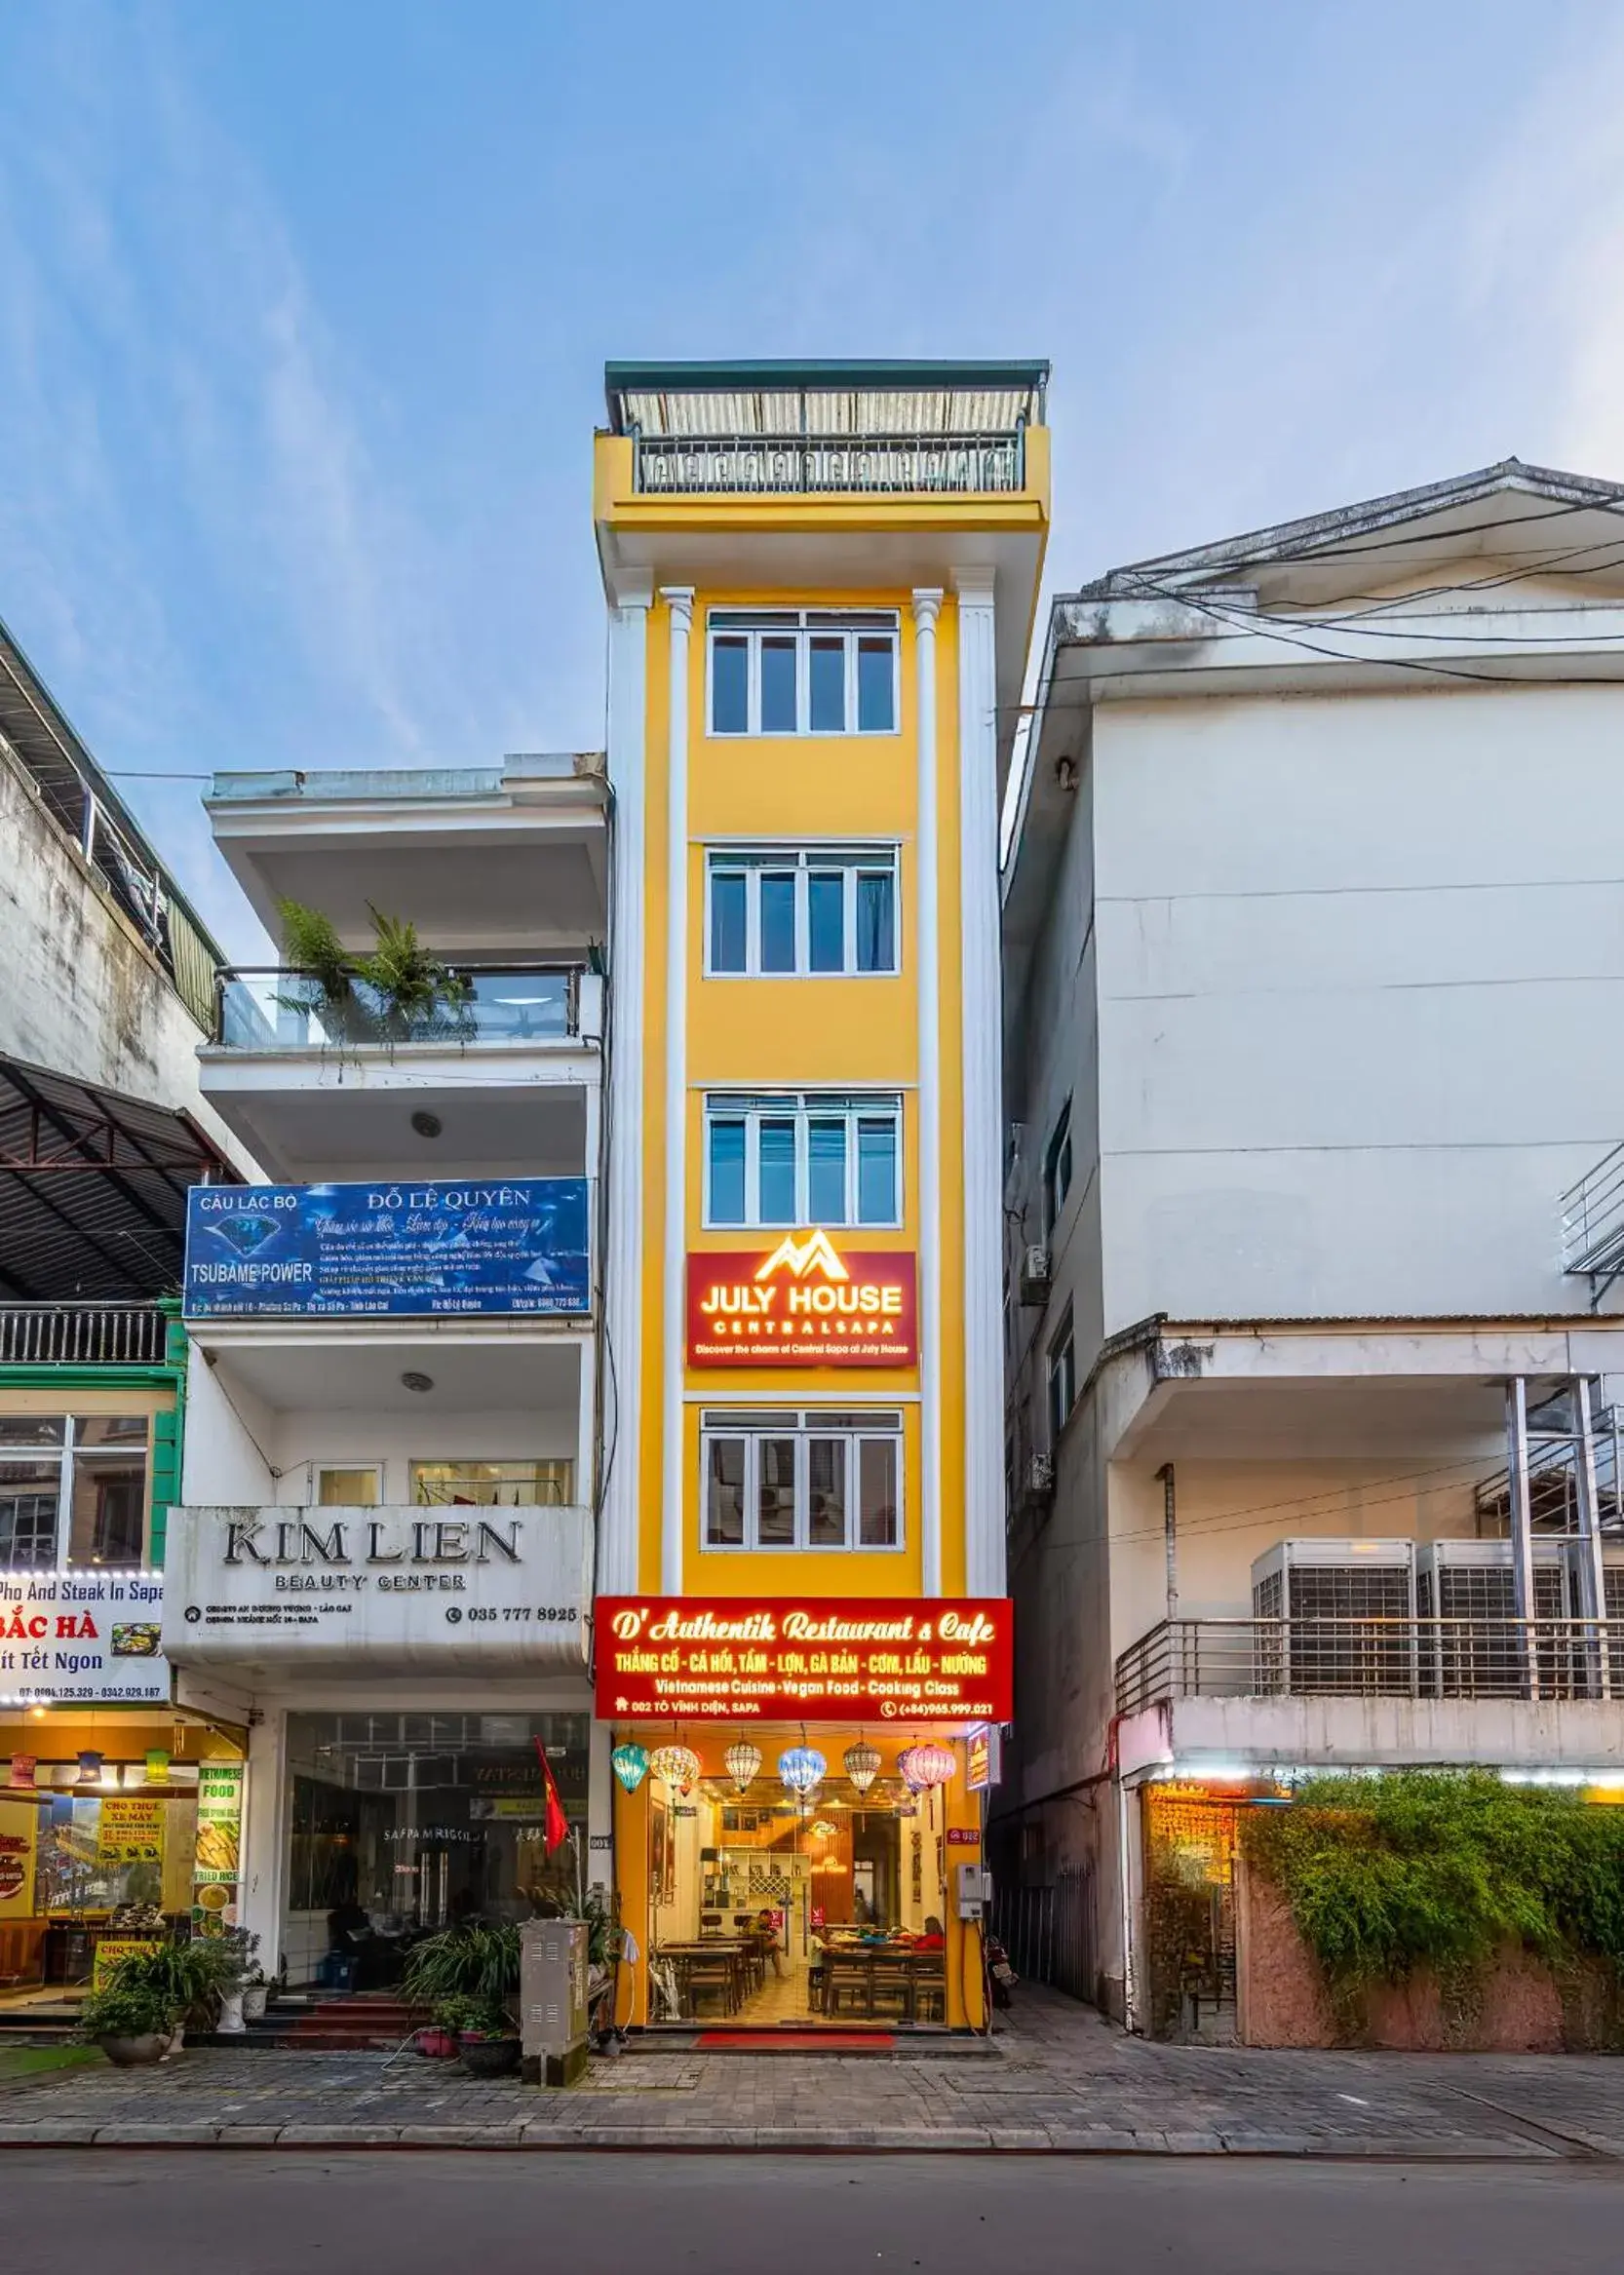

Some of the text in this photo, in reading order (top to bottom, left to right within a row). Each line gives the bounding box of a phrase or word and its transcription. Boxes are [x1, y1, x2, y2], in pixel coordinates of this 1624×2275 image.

[367, 1186, 531, 1212] ĐỖ LỆ QUYÊN
[191, 1263, 257, 1284] TSUBAME
[261, 1263, 312, 1283] POWER
[700, 1284, 904, 1314] JULY HOUSE
[734, 1344, 750, 1355] the
[223, 1521, 523, 1564] KIM LIEN
[27, 1581, 57, 1600] And
[61, 1581, 104, 1601] Steak
[110, 1582, 124, 1600] In
[275, 1575, 468, 1592] BEAUTY CENTER
[56, 1609, 99, 1639] HÀ
[468, 1607, 577, 1622] 035 777 8925
[648, 1610, 777, 1641] Authentik
[782, 1611, 914, 1641] Restaurant
[938, 1611, 995, 1647] Cafe
[20, 1646, 49, 1670] Tết
[55, 1652, 103, 1674] Ngon
[656, 1678, 730, 1694] Vietnamese
[731, 1679, 776, 1694] Cuisine
[782, 1680, 824, 1698] Vegan
[828, 1680, 859, 1695] Food
[868, 1680, 921, 1698] Cooking
[924, 1680, 960, 1696] Class
[731, 1702, 760, 1714] SAPA
[203, 1785, 235, 1798] FOOD
